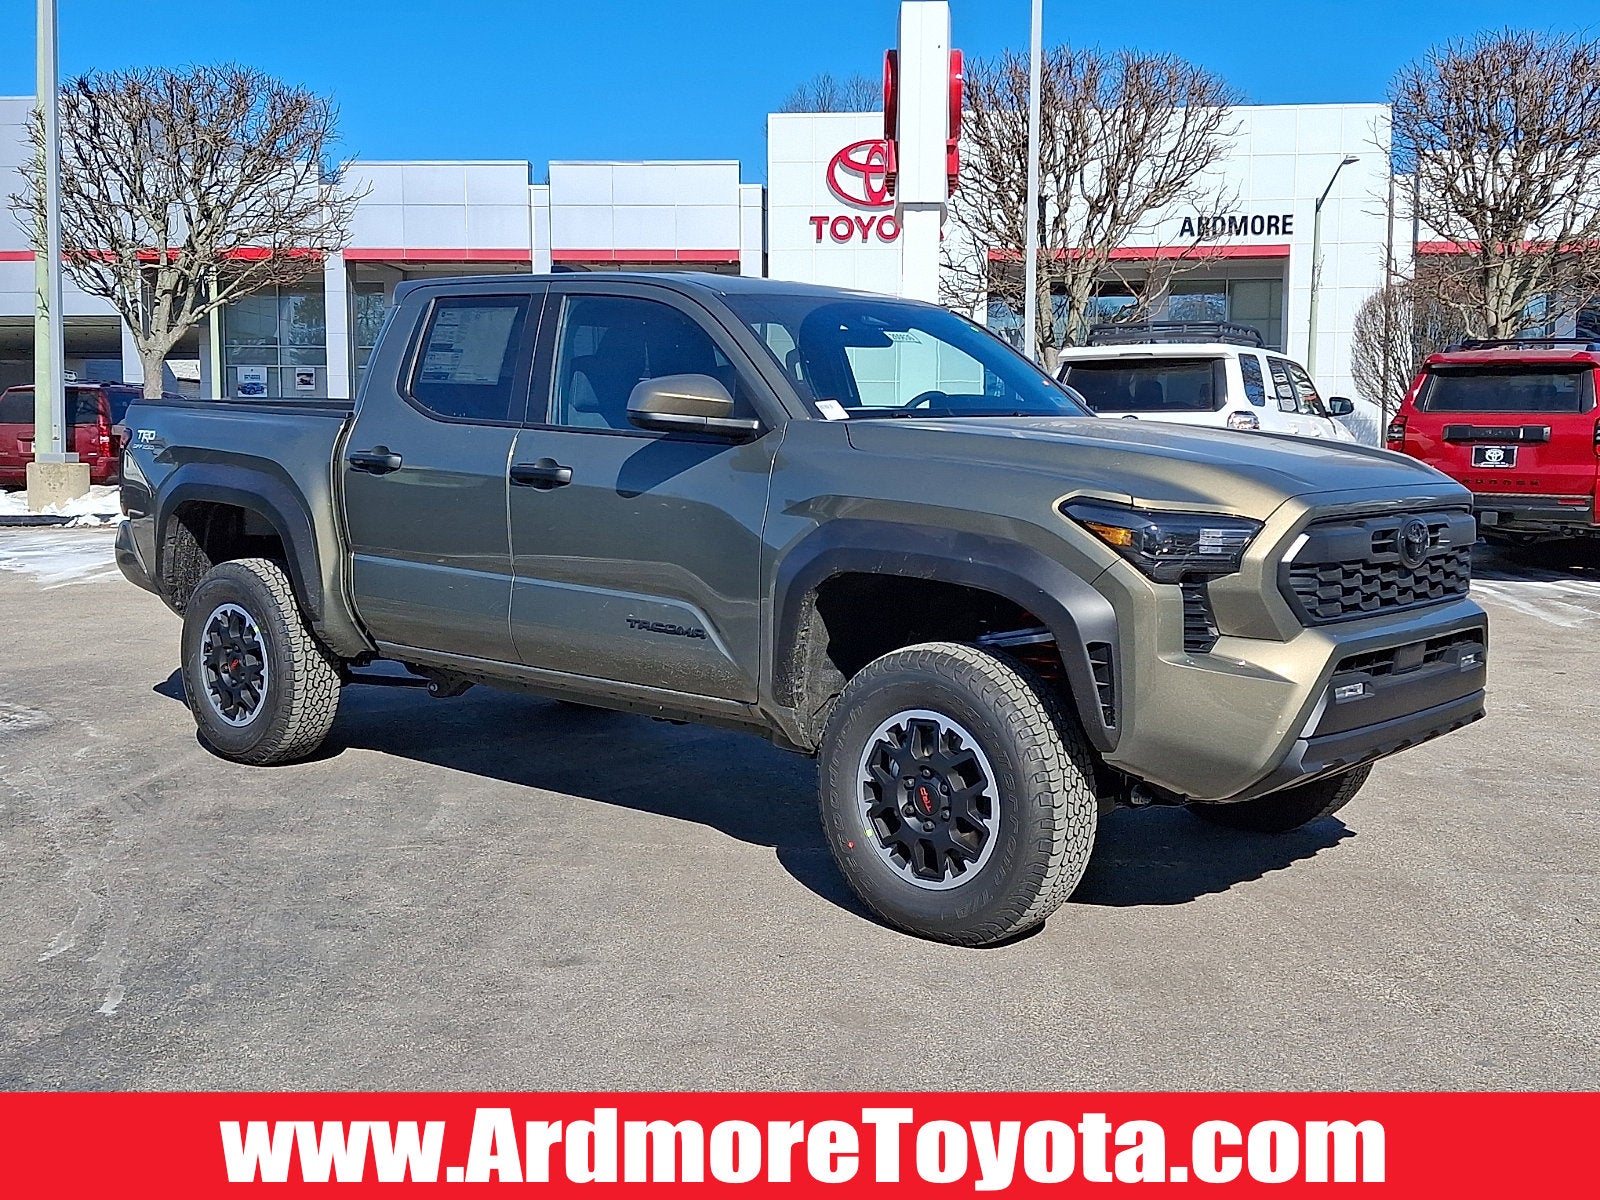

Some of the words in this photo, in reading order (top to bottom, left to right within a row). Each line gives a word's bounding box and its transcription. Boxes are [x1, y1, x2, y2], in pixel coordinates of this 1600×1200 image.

[809, 215, 944, 243] TOYO
[1179, 214, 1294, 237] ARDMORE
[137, 429, 156, 443] TRD
[625, 618, 707, 640] TACOMA
[919, 786, 932, 812] TRD
